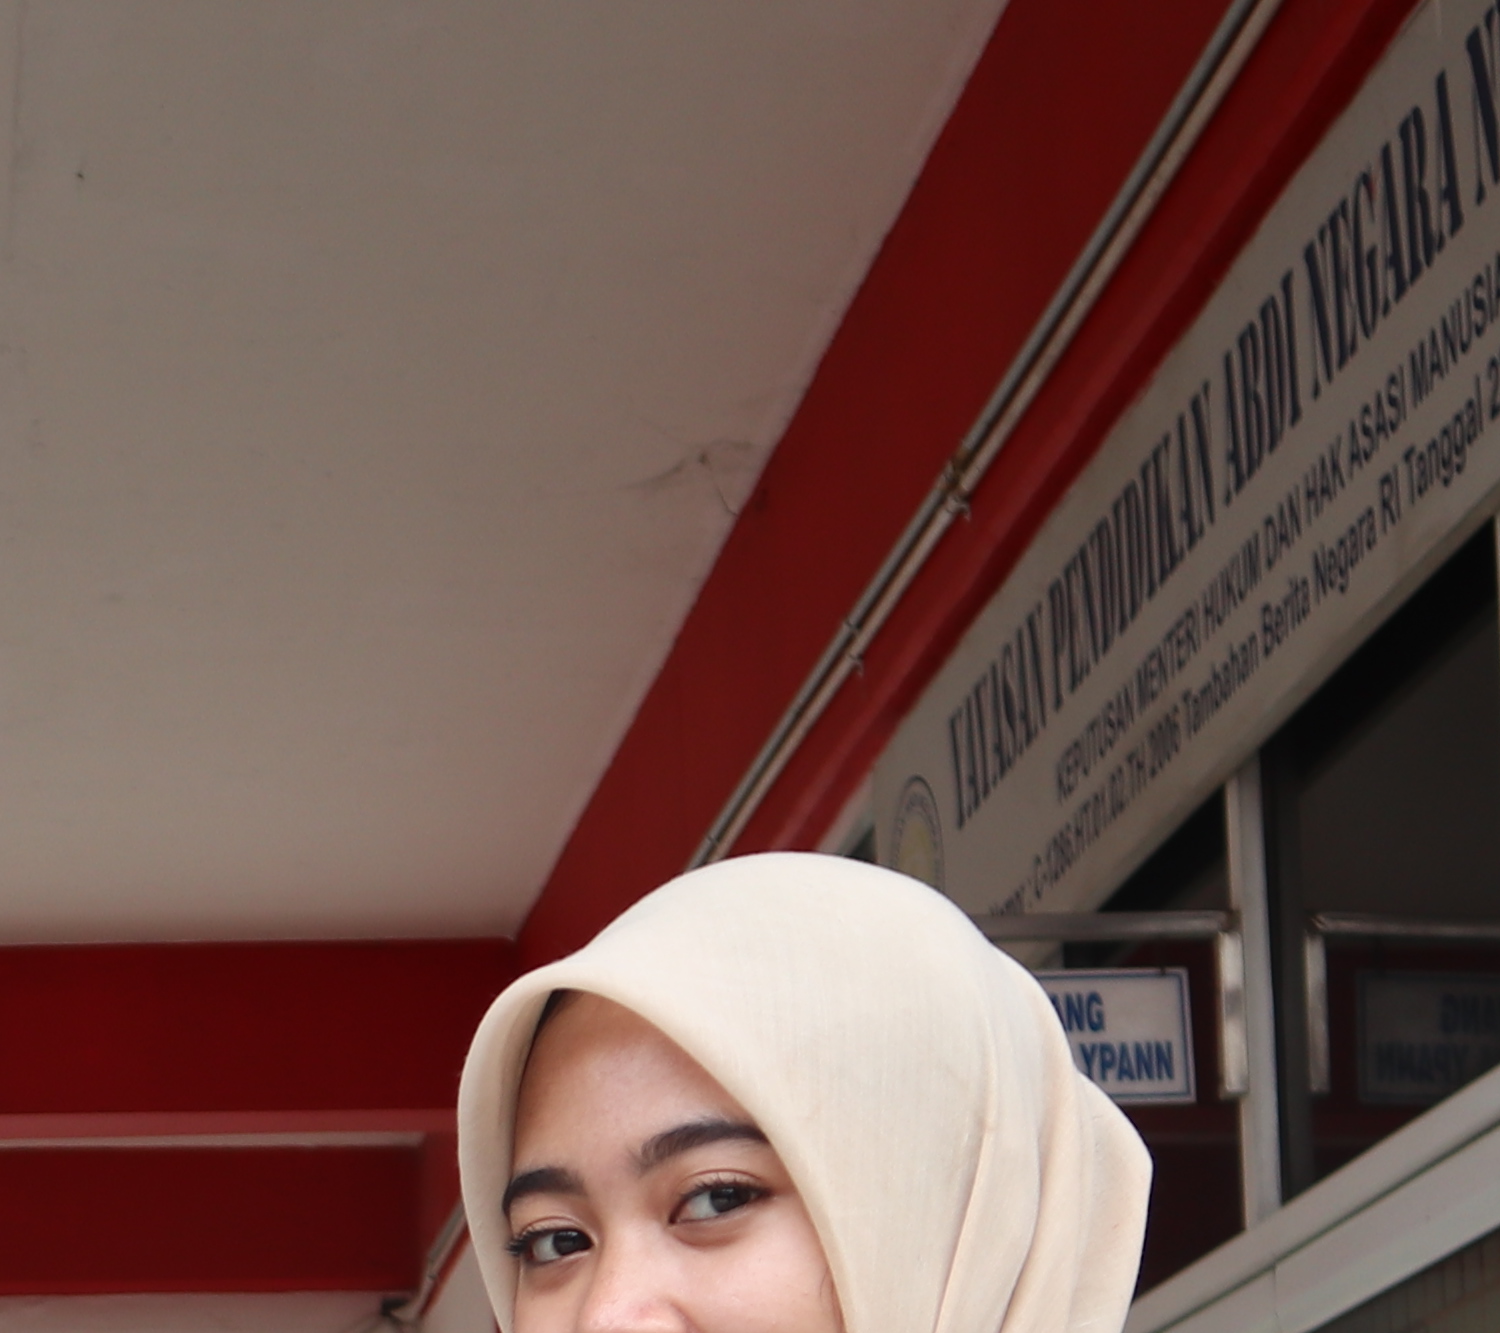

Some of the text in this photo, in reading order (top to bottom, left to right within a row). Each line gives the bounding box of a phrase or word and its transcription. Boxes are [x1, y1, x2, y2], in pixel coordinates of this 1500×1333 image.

[949, 602, 1049, 829] YAYASAN
[1050, 380, 1214, 712] PENDIDIKAN
[1223, 267, 1302, 507] ABDI
[1302, 68, 1464, 400] NEGARA
[1057, 680, 1135, 806] KEPUTUSAN
[1201, 531, 1263, 647] HUKUM
[1264, 484, 1301, 570] DAN
[1303, 433, 1346, 528] HAK
[1349, 362, 1406, 481] ASASI
[1260, 576, 1311, 656] Berita
[1311, 504, 1377, 604] Negara
[1378, 464, 1401, 536] RI
[1402, 372, 1484, 506] Tanggal
[1078, 1040, 1174, 1082] YPANN
